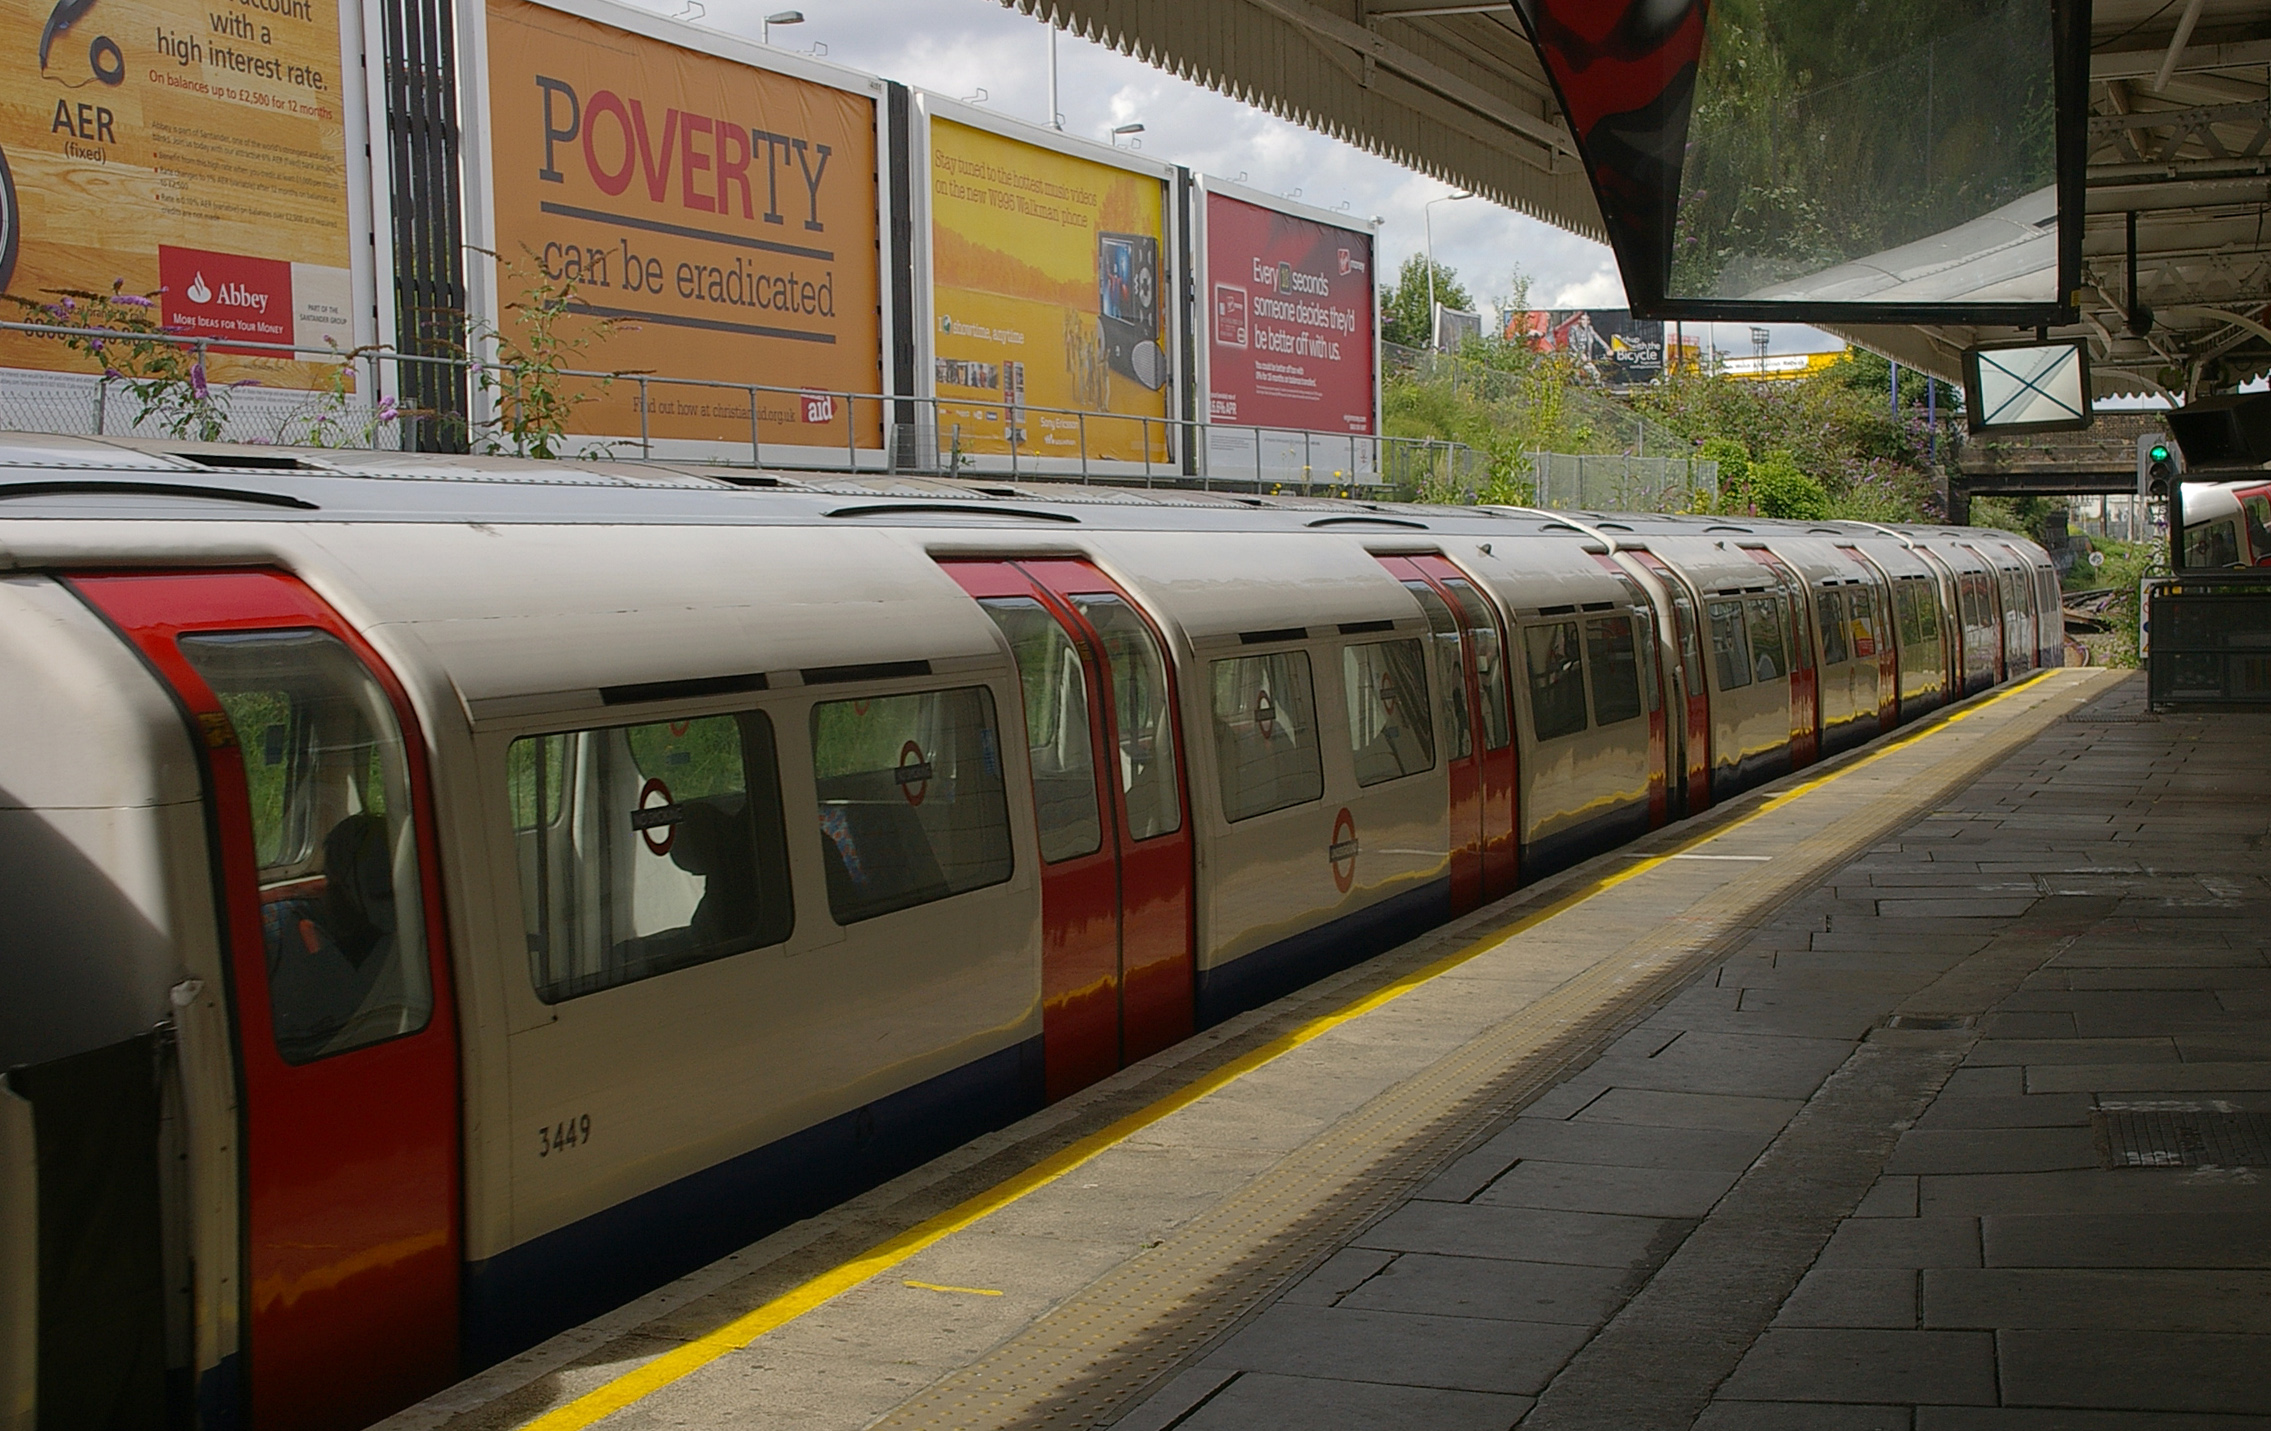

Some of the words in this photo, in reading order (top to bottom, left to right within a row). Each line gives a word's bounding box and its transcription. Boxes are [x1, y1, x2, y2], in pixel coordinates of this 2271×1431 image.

[209, 10, 255, 41] with
[261, 25, 272, 45] a
[157, 27, 202, 66] high
[209, 40, 282, 81] interest
[287, 65, 328, 91] rate.
[149, 69, 165, 85] On
[167, 72, 209, 94] balances
[211, 85, 224, 99] up
[226, 88, 236, 99] to
[239, 89, 270, 107] £2,500
[271, 97, 285, 109] for
[288, 99, 298, 112] 12
[300, 103, 333, 120] months
[51, 98, 116, 145] AER
[64, 141, 107, 165] (fixed)
[536, 74, 832, 232] POVERTY
[935, 149, 957, 176] Stay
[958, 157, 985, 179] tuned
[987, 166, 996, 182] to
[998, 166, 1012, 187] the
[1013, 170, 1043, 194] hottest
[1044, 181, 1069, 201] music
[1070, 187, 1097, 207] videos
[935, 179, 948, 196] on
[949, 180, 965, 199] the
[967, 187, 987, 204] new
[988, 188, 1016, 212] W995
[1016, 195, 1059, 222] Walkman
[1061, 208, 1087, 228] phone
[544, 241, 610, 288] can
[621, 238, 664, 295] be
[676, 257, 835, 318] eradicated
[1253, 256, 1279, 292] Every
[1292, 272, 1329, 297] seconds
[216, 283, 268, 314] Abbey
[307, 304, 321, 313] PART
[321, 305, 328, 313] OF
[329, 306, 339, 314] THE
[1253, 296, 1295, 322] someone
[1296, 299, 1329, 328] decides
[1330, 306, 1355, 337] they'd
[330, 315, 348, 326] GROUP
[1254, 323, 1267, 350] be
[1268, 326, 1295, 354] better
[1296, 331, 1309, 356] off
[1309, 334, 1328, 359] with
[1616, 348, 1658, 364] Bicycle
[1648, 341, 1661, 351] the
[632, 396, 656, 413] Fid
[658, 401, 675, 415] out
[677, 401, 698, 417] how
[701, 405, 711, 418] at
[713, 403, 796, 425] christianid.org.uk
[807, 395, 834, 422] aid
[1040, 416, 1055, 430] Sony
[539, 1113, 591, 1158] 3449
